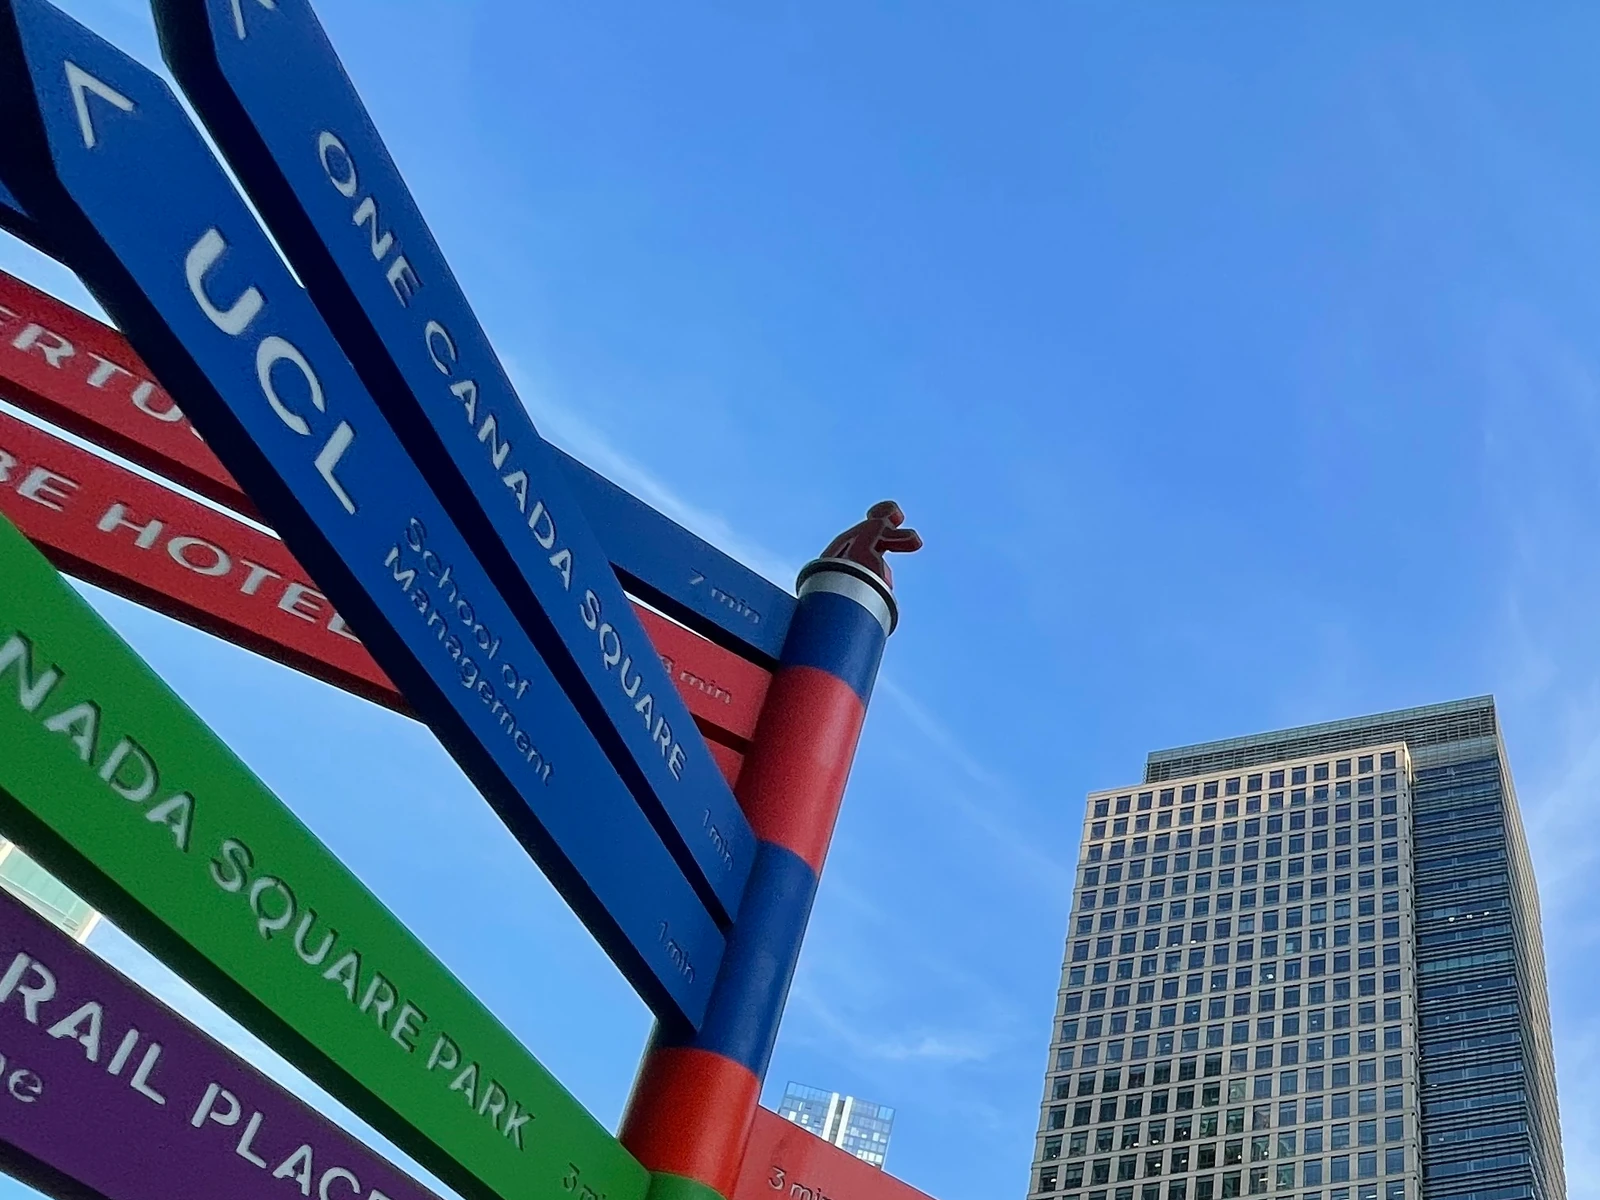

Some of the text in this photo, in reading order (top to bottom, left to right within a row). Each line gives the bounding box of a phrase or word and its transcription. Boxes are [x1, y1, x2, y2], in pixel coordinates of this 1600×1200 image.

[184, 227, 356, 515] UCL
[318, 130, 687, 781] ONE CANADA SQUARE
[406, 517, 532, 699] School of
[711, 587, 761, 624] min
[384, 545, 554, 786] Management
[680, 670, 732, 704] min
[703, 808, 734, 871] 1 min
[209, 837, 427, 1053] SQUARE
[426, 1032, 535, 1150] PARK
[658, 920, 695, 984] 1 min
[0, 951, 166, 1106] RAIL
[563, 1161, 580, 1192] 3
[767, 1165, 786, 1191] 3
